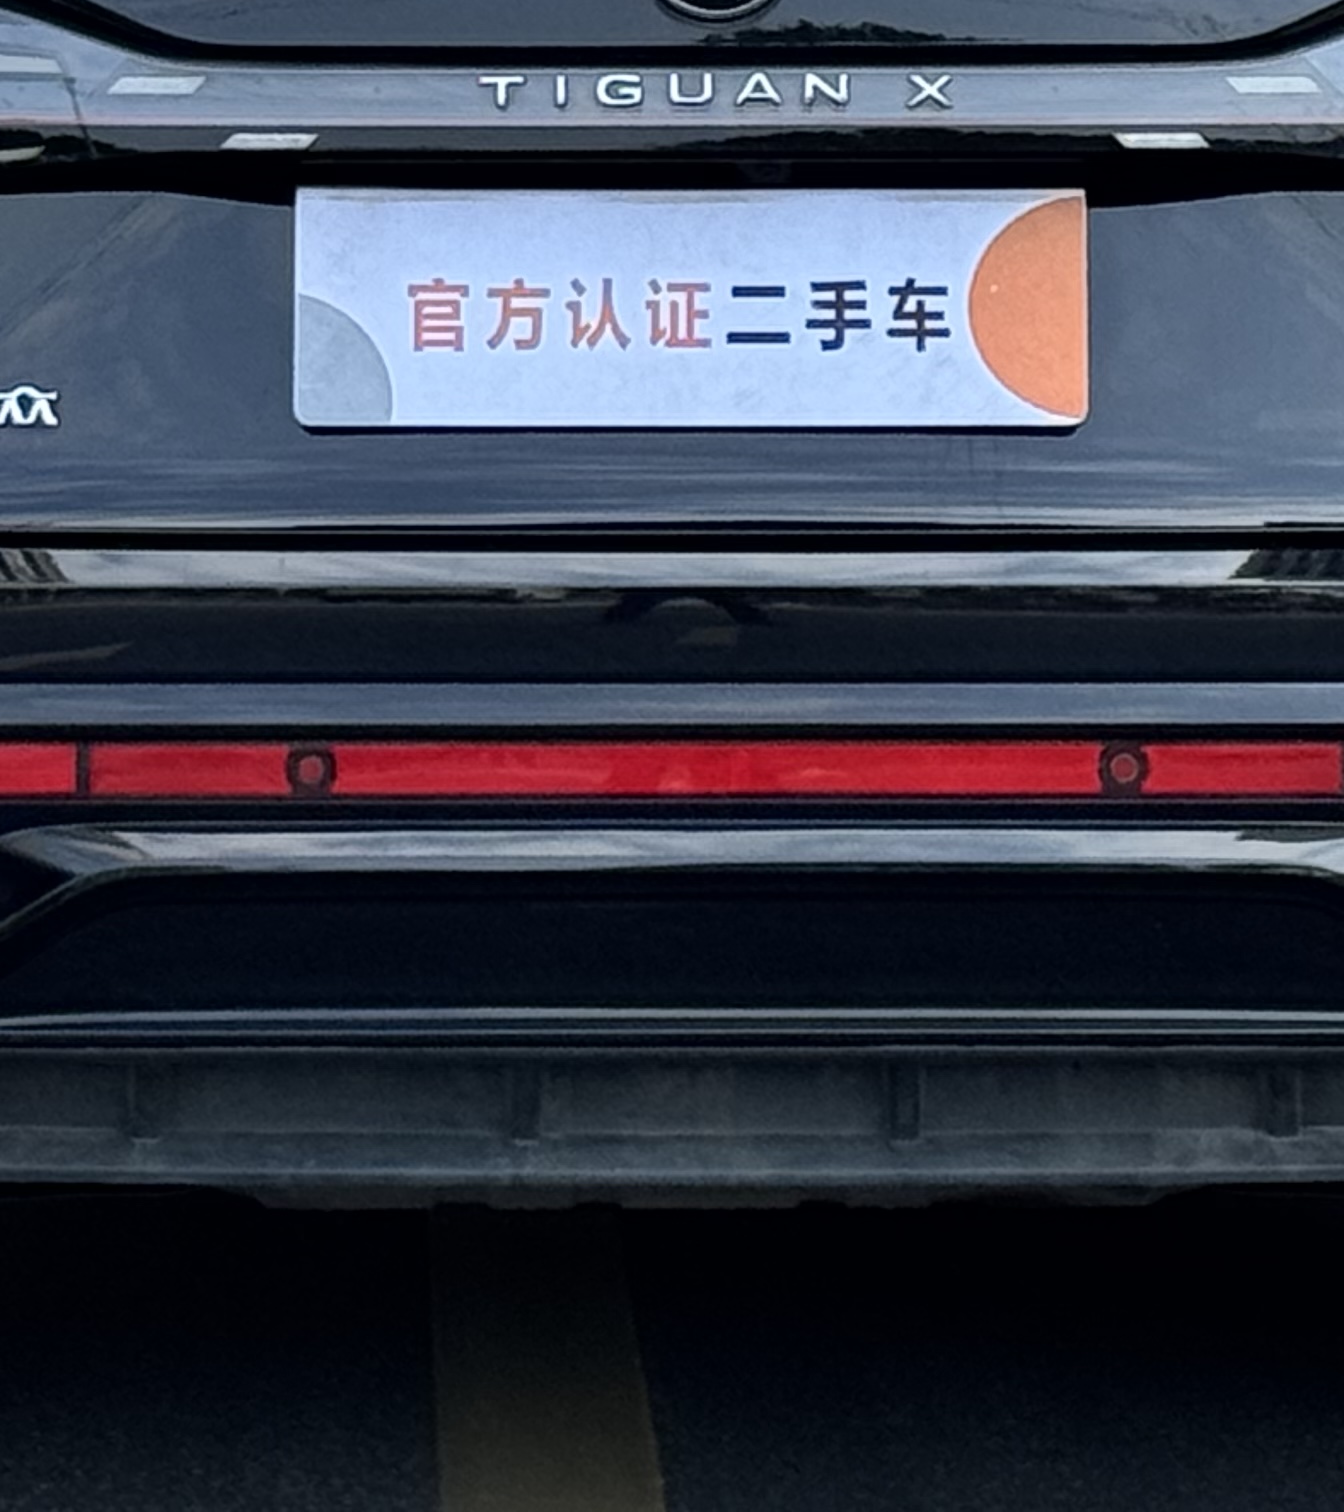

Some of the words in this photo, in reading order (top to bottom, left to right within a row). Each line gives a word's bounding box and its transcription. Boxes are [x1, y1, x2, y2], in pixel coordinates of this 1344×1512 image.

[479, 71, 850, 107] TIGUAN
[908, 73, 953, 107] X
[408, 276, 952, 353] 官方认证二手车
